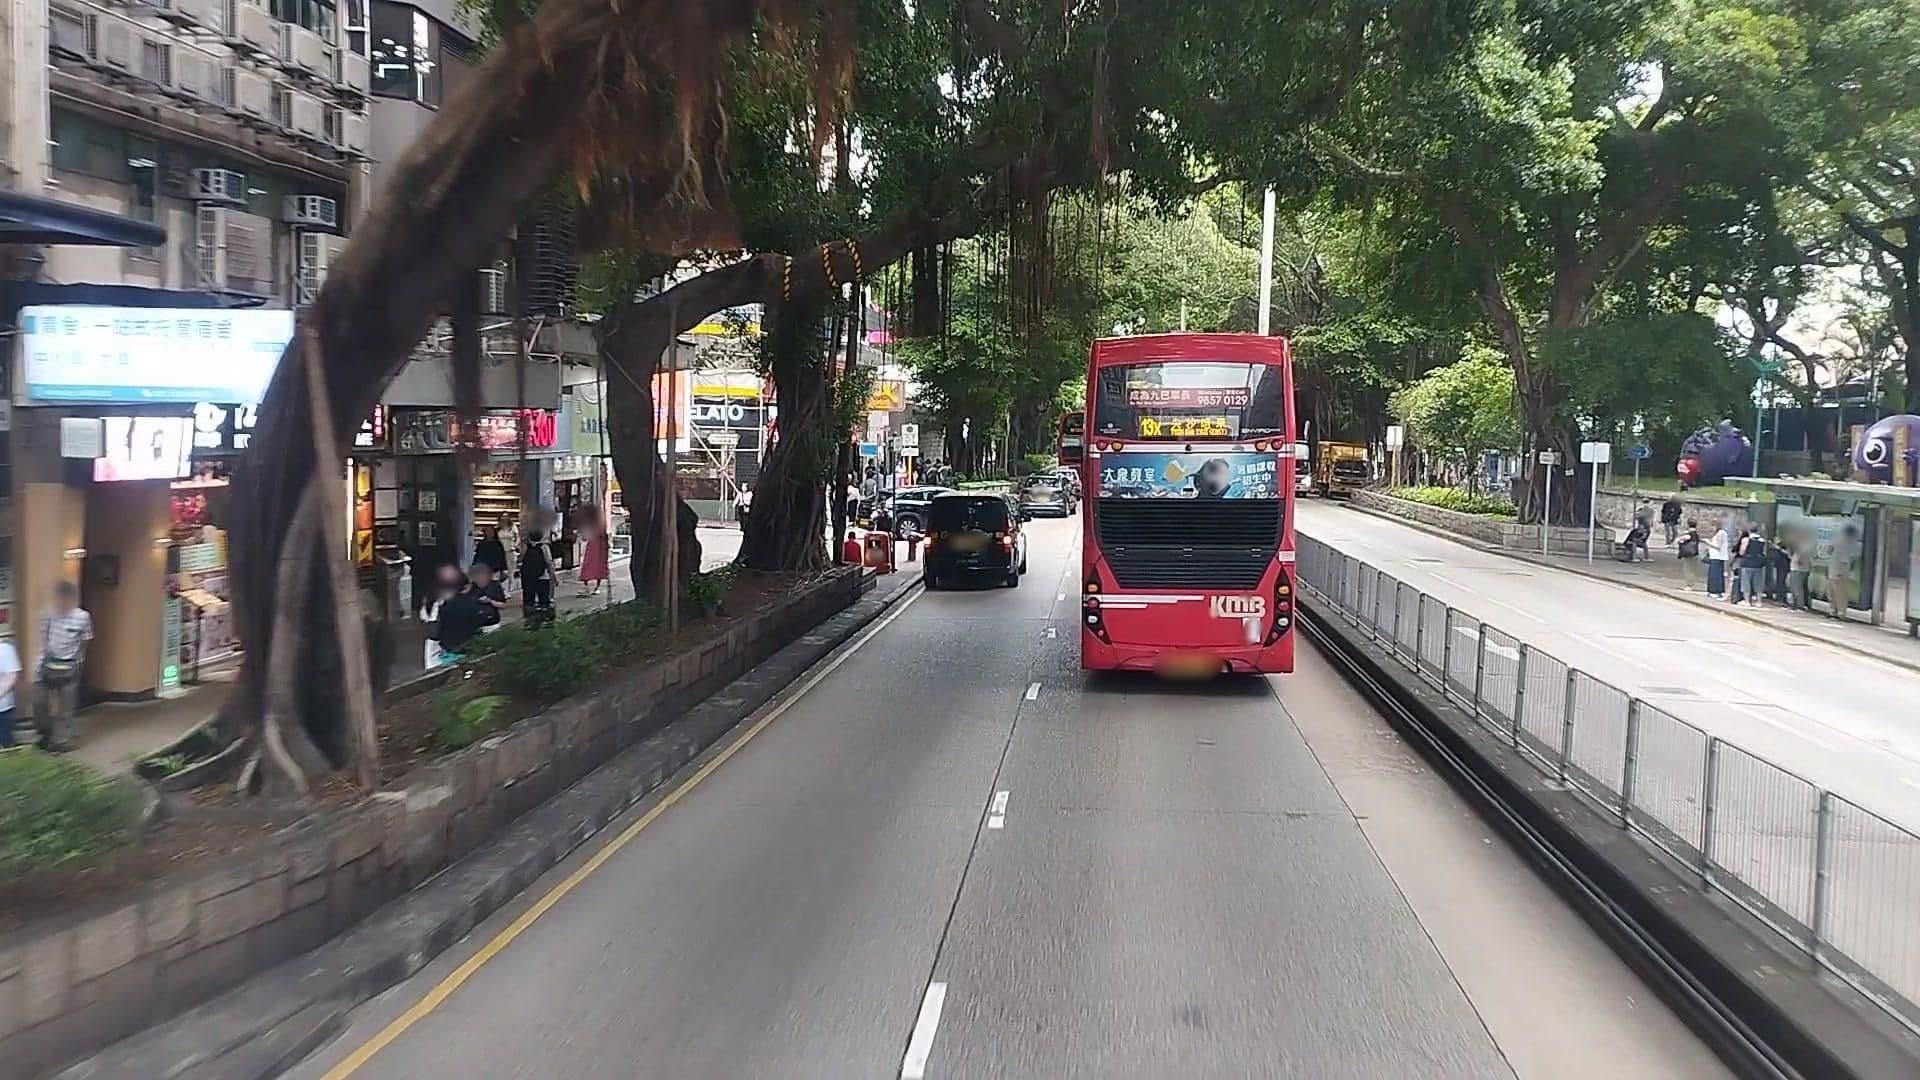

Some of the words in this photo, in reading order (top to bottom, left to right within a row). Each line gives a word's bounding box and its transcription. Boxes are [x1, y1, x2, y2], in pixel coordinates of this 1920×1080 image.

[1197, 395, 1221, 406] 9857
[1223, 395, 1249, 406] 0129
[1141, 417, 1161, 437] 13X
[1242, 472, 1272, 486] 招生中
[1210, 595, 1266, 618] KMB
